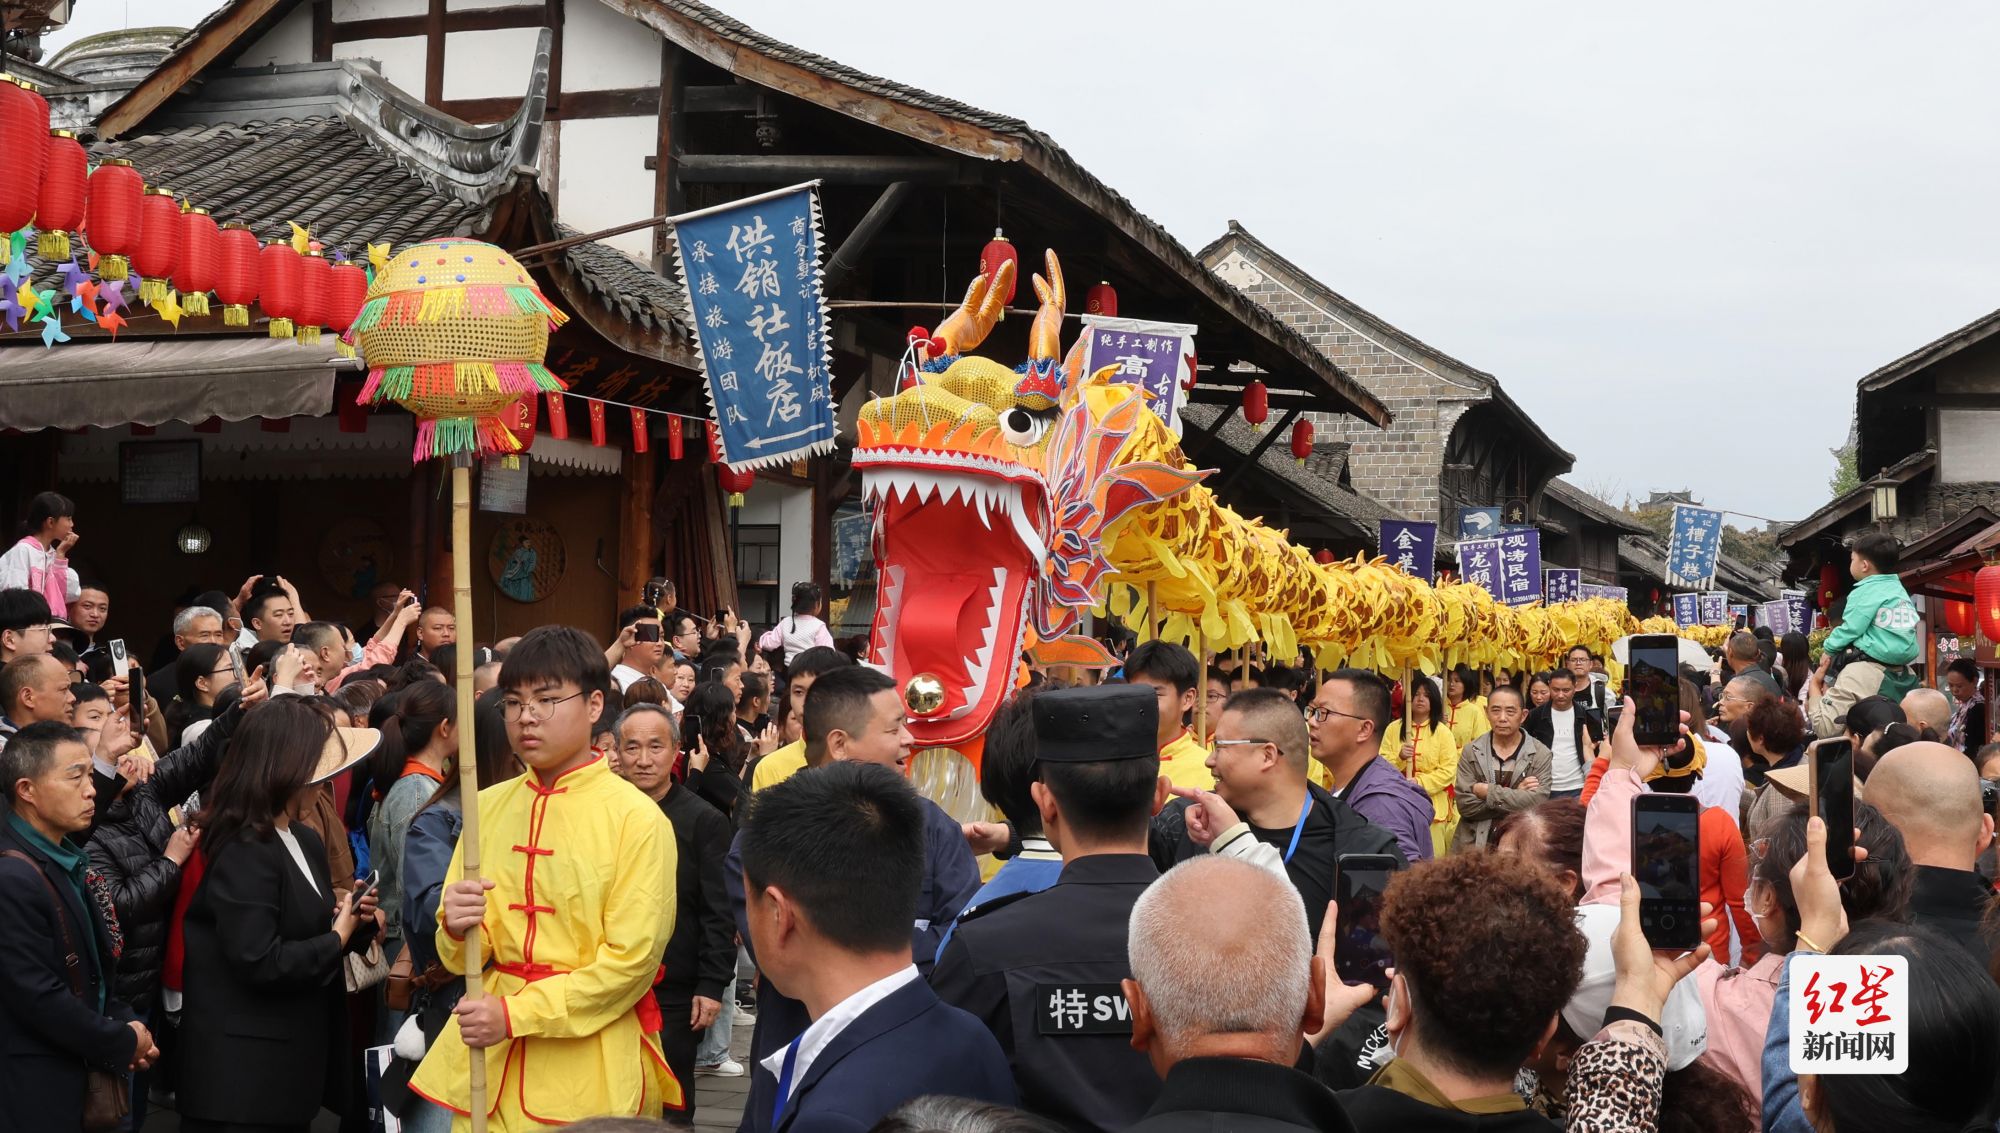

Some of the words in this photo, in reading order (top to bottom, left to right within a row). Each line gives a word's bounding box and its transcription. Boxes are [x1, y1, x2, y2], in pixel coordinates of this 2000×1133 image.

[692, 240, 748, 426] 承接旅游团队
[726, 216, 803, 428] 供销社饭店
[1101, 333, 1174, 354] 纯手工制作
[1115, 354, 1154, 386] 高
[1505, 534, 1530, 592] 观涛民宿
[1681, 525, 1708, 579] 槽子糕
[1357, 1021, 1388, 1070] MICKE
